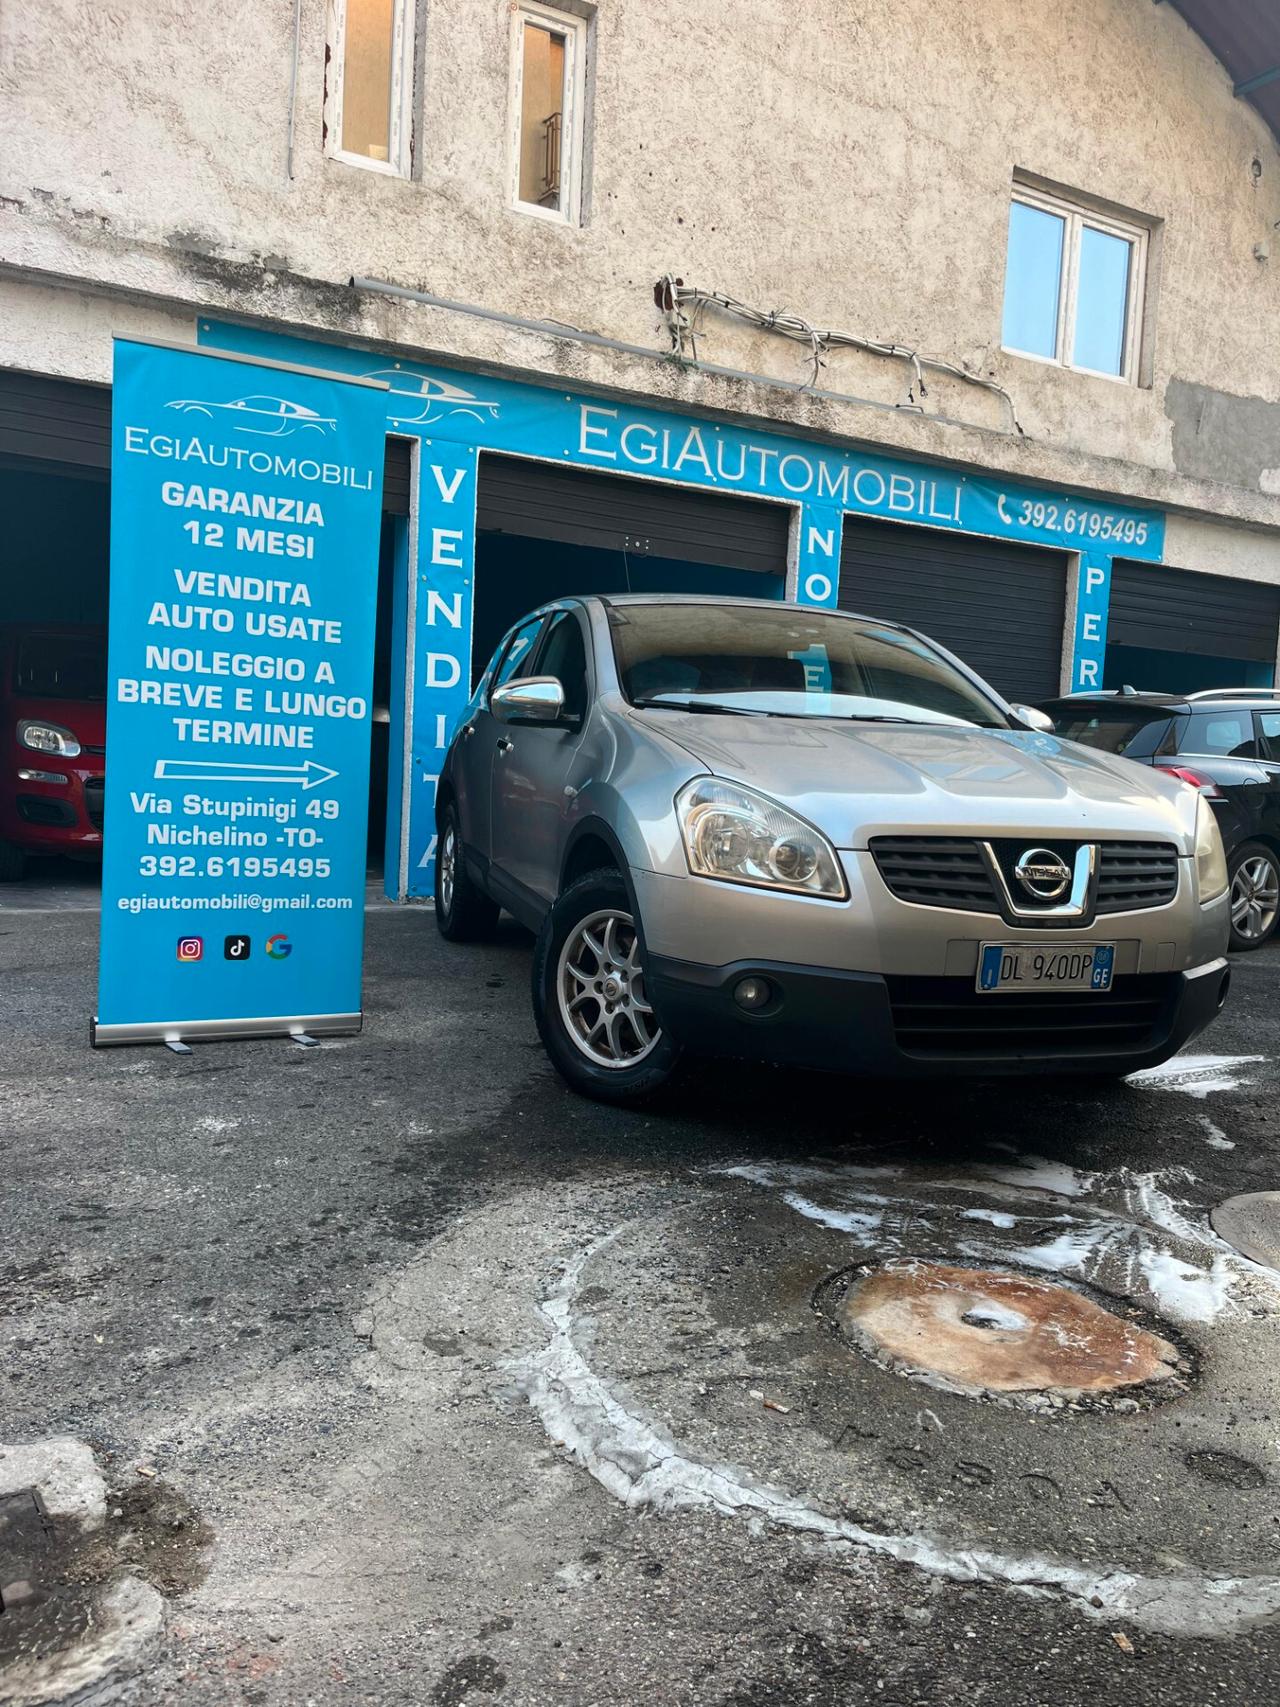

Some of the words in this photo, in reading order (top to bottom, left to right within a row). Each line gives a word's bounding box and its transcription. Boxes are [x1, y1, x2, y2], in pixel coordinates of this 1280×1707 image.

[161, 481, 325, 527] GARANZIA
[1016, 500, 1149, 546] 392.6195495
[183, 521, 224, 547] 12
[236, 528, 314, 559] MESI
[174, 569, 312, 607] VENDITA
[148, 603, 234, 633] AUTO
[246, 613, 342, 644] USATE
[146, 646, 305, 681] NOLEGGIO
[314, 662, 335, 684] A
[117, 678, 222, 709] BREVE
[235, 688, 253, 711] E
[265, 690, 366, 719] LUNGO
[173, 718, 314, 749] TERMINE
[130, 792, 172, 814] Via
[183, 794, 296, 824] Stupinigi
[305, 800, 340, 819] 49
[147, 824, 268, 847] Nichelino
[276, 828, 324, 847] -TO-
[139, 856, 331, 878] 392.6195495
[1022, 866, 1069, 878] NISSAN
[118, 893, 353, 914] egiautomobili@gmail.com
[1000, 954, 1024, 981] DL
[1032, 954, 1093, 981] 940DP
[1093, 968, 1109, 984] GE
